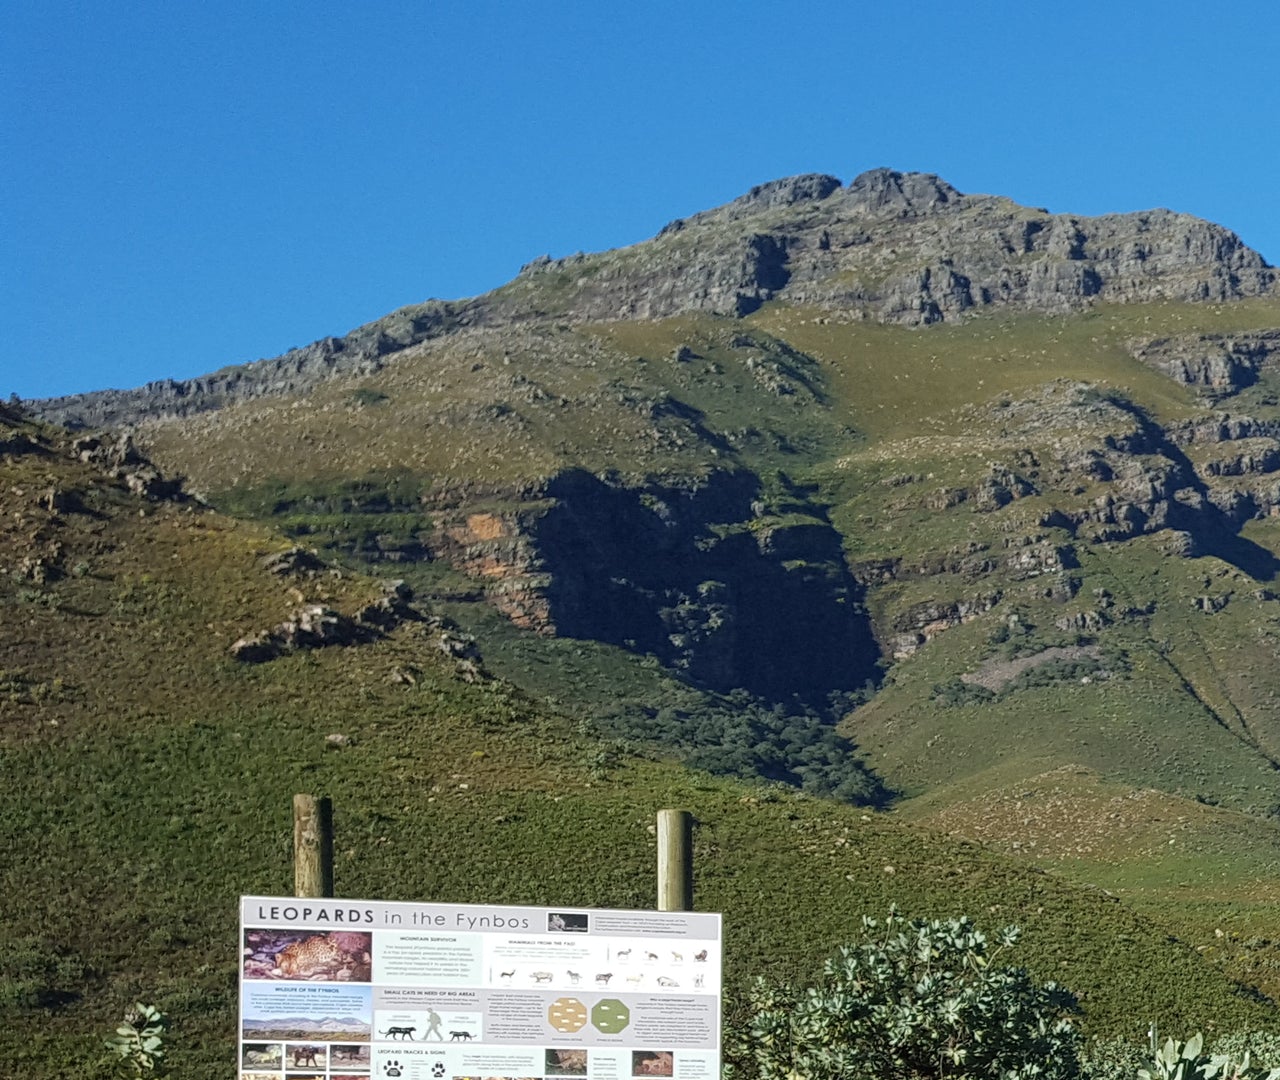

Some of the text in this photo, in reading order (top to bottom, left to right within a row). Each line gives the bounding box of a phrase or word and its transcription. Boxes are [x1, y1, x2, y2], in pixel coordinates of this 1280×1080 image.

[258, 906, 529, 929] LEOPARDS in the Fynbos
